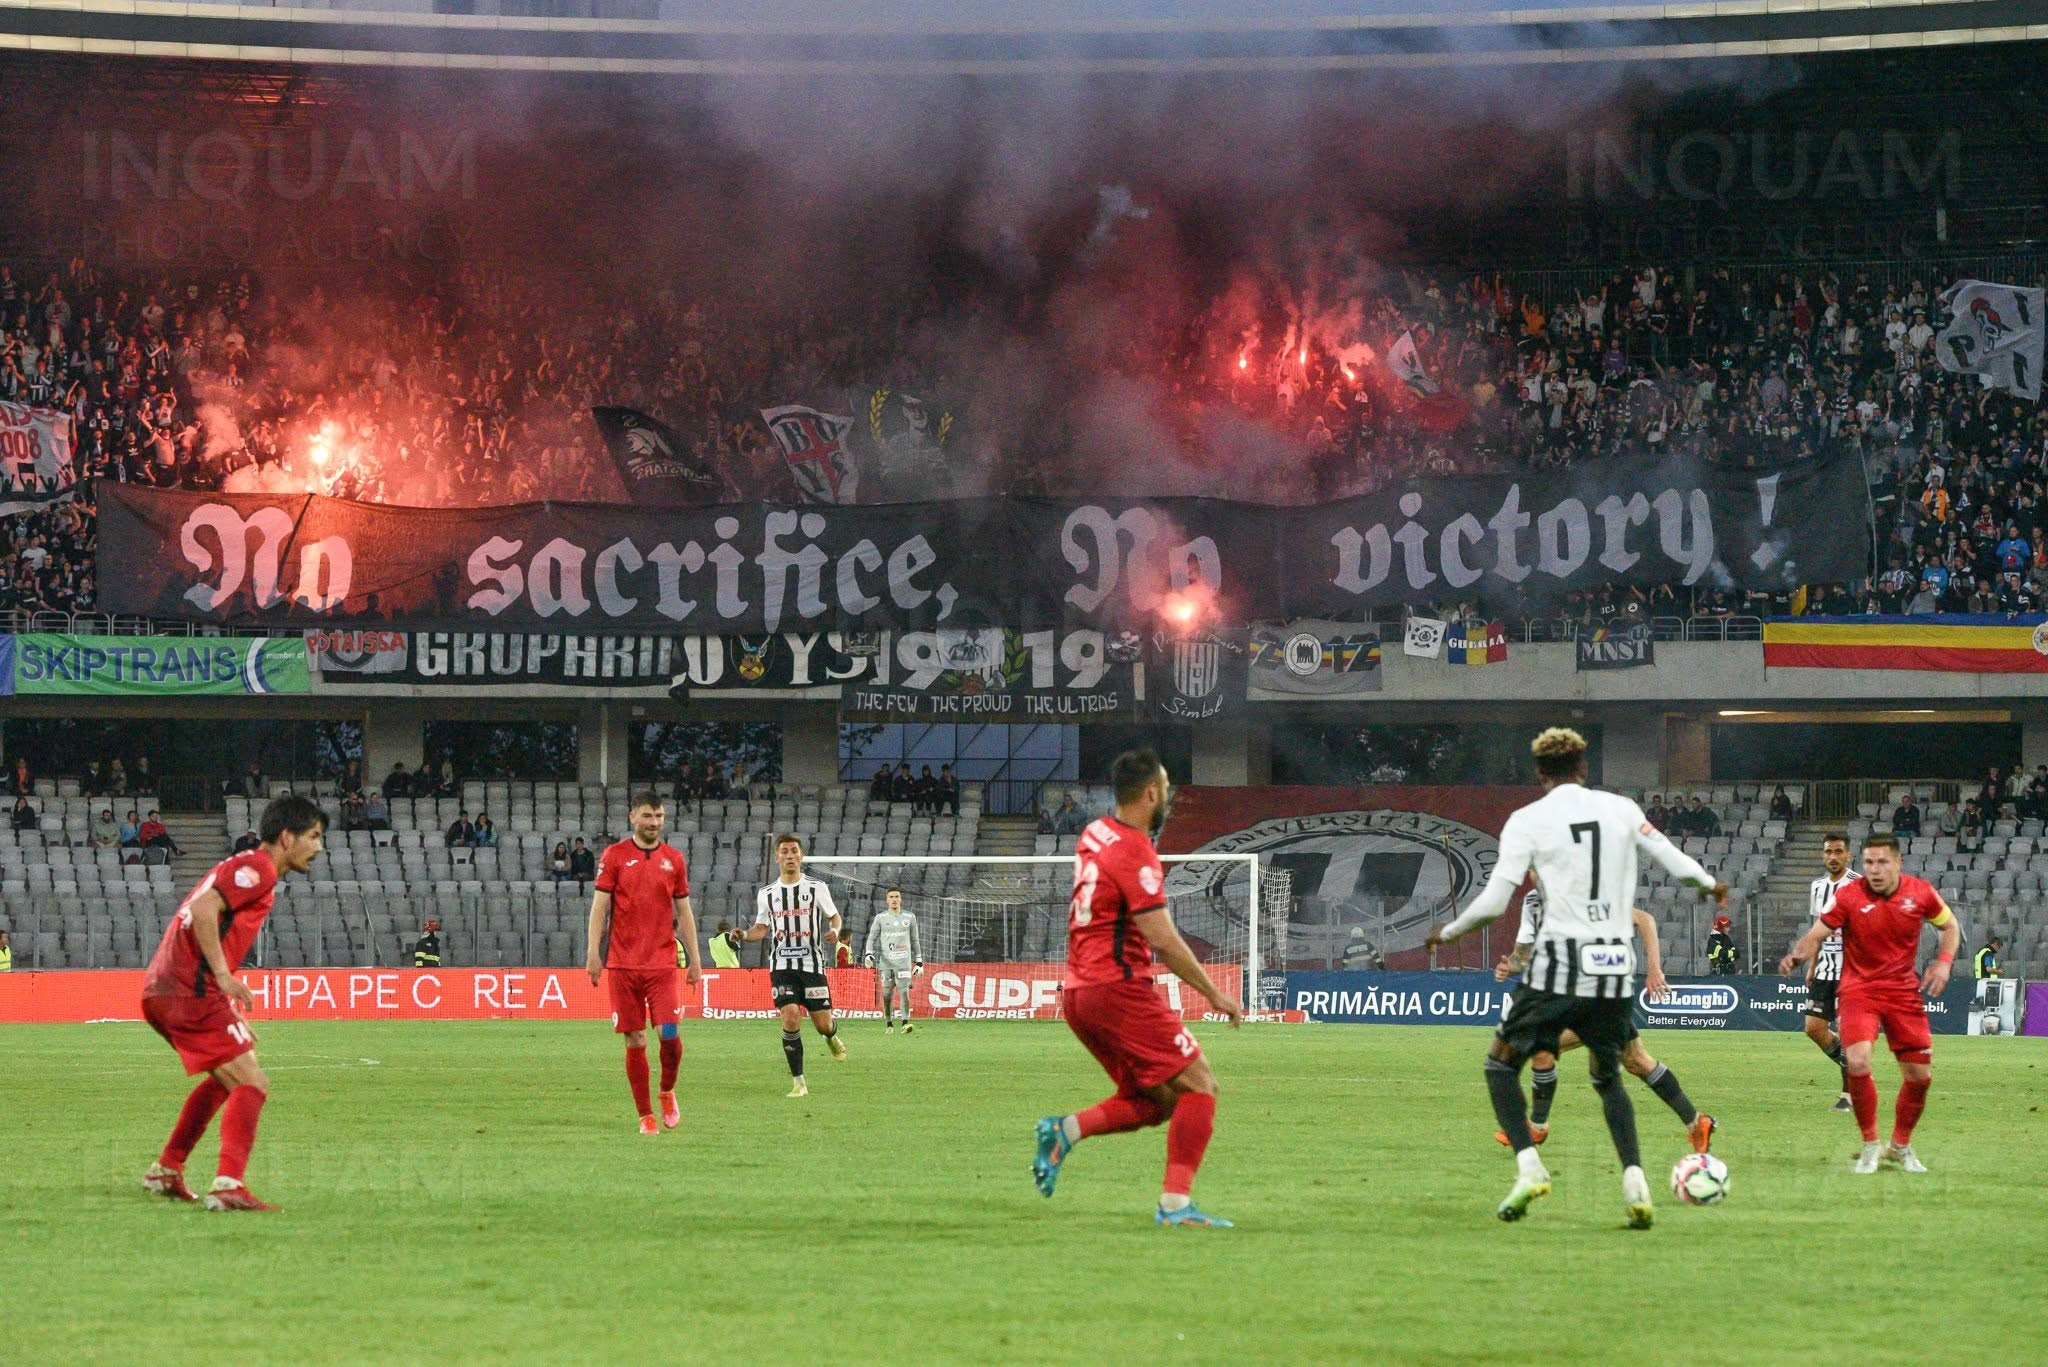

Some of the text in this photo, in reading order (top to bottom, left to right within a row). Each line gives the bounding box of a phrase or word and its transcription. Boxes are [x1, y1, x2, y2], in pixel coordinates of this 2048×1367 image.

[0, 428, 42, 460] 008
[181, 503, 353, 613] No
[466, 510, 958, 634] sacrifice,
[1330, 483, 1715, 595] victory
[306, 630, 405, 654] POTAISSA
[1582, 639, 1650, 662] MNST
[20, 644, 240, 683] SKIPTRANS
[856, 692, 1118, 714] THE FEW THE PROUD THE ULTRAS
[1161, 694, 1224, 719] Simbol
[1569, 820, 1601, 901] 7
[1587, 902, 1612, 922] ELY
[231, 974, 337, 1009] HIPA
[1296, 985, 1423, 1015] PRIMĂRIA
[1649, 991, 1729, 1009] DeLonghi
[1750, 999, 1794, 1012] inspiră
[1647, 1015, 1727, 1028] Better Everyday
